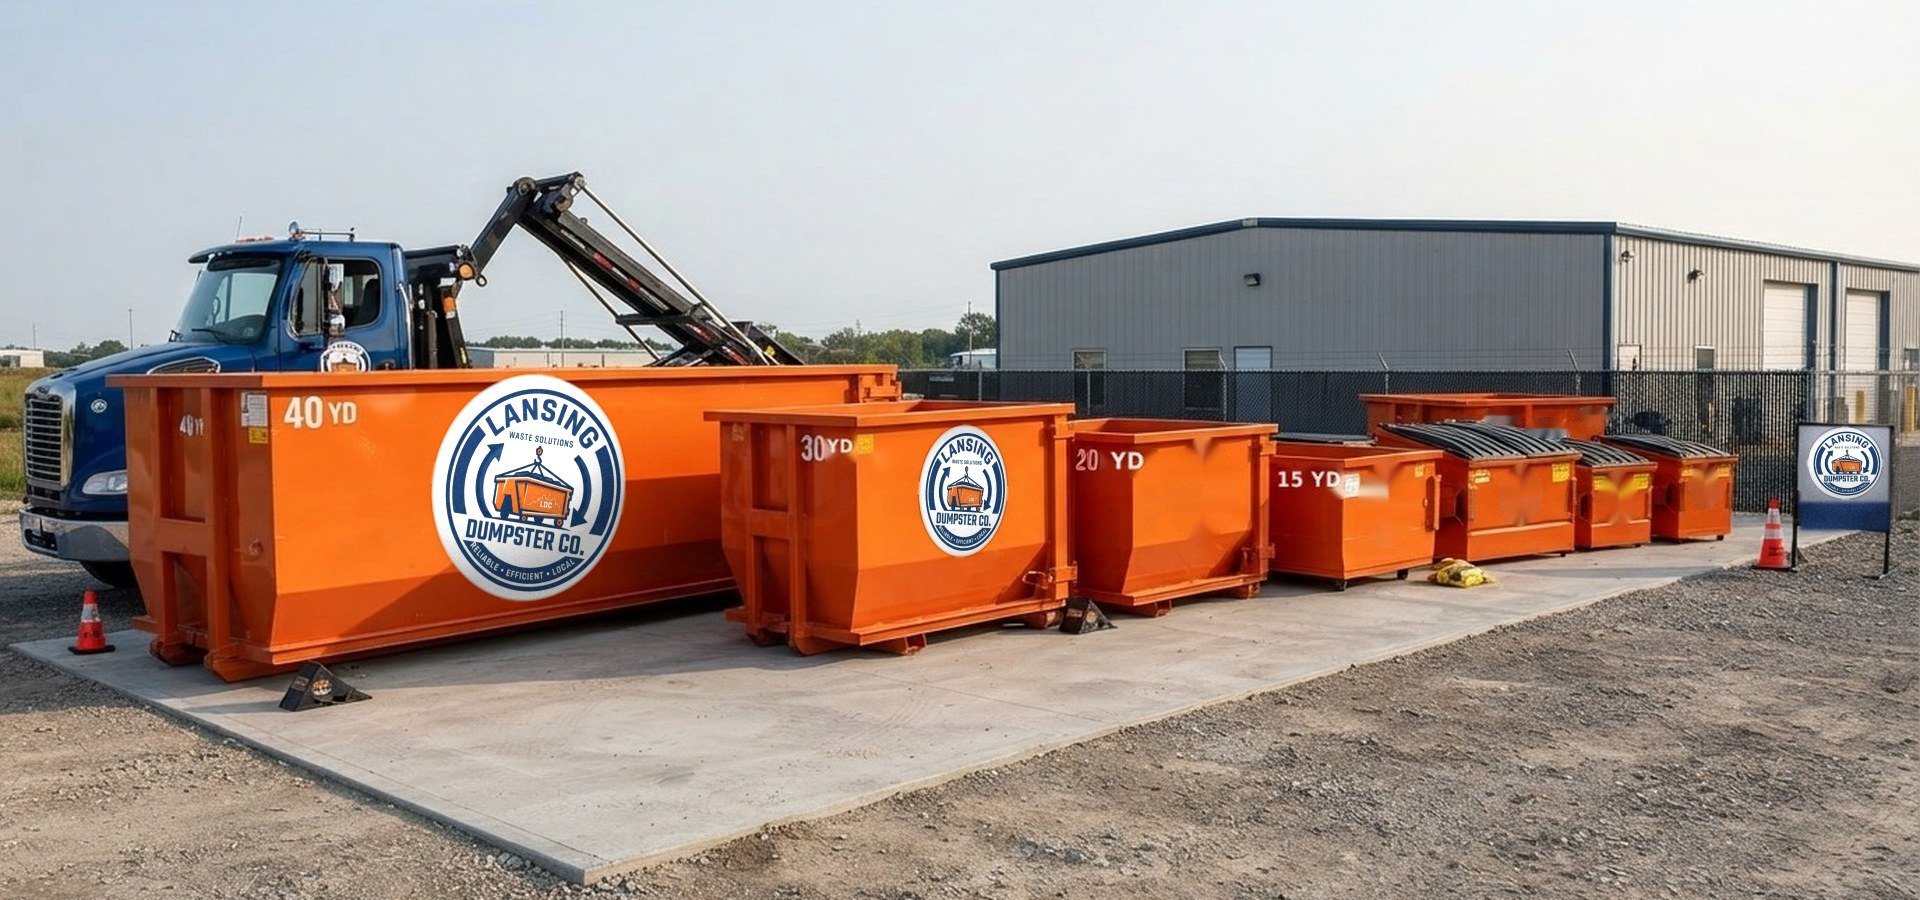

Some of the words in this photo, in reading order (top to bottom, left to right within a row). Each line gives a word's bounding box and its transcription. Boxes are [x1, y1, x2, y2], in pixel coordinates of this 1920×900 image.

[284, 395, 323, 429] 40
[327, 401, 357, 424] YD
[485, 398, 599, 449] LANSING
[509, 431, 532, 442] WASTE
[534, 435, 574, 448] SOLUTIONS
[801, 434, 825, 462] 30
[827, 438, 853, 454] YD
[941, 438, 994, 465] LANSING
[1825, 434, 1869, 449] LANSING
[1075, 448, 1099, 471] 20
[1110, 451, 1144, 470] YD
[1278, 470, 1303, 488] 15
[1311, 470, 1341, 488] YD
[936, 512, 977, 526] DUMPSTER
[978, 514, 991, 527] CO.
[465, 518, 554, 551] DUMPSTER
[558, 533, 584, 556] CO.
[470, 541, 500, 571] RELIABLE
[506, 569, 543, 581] EFFICIENT
[552, 558, 576, 576] LOCAL
